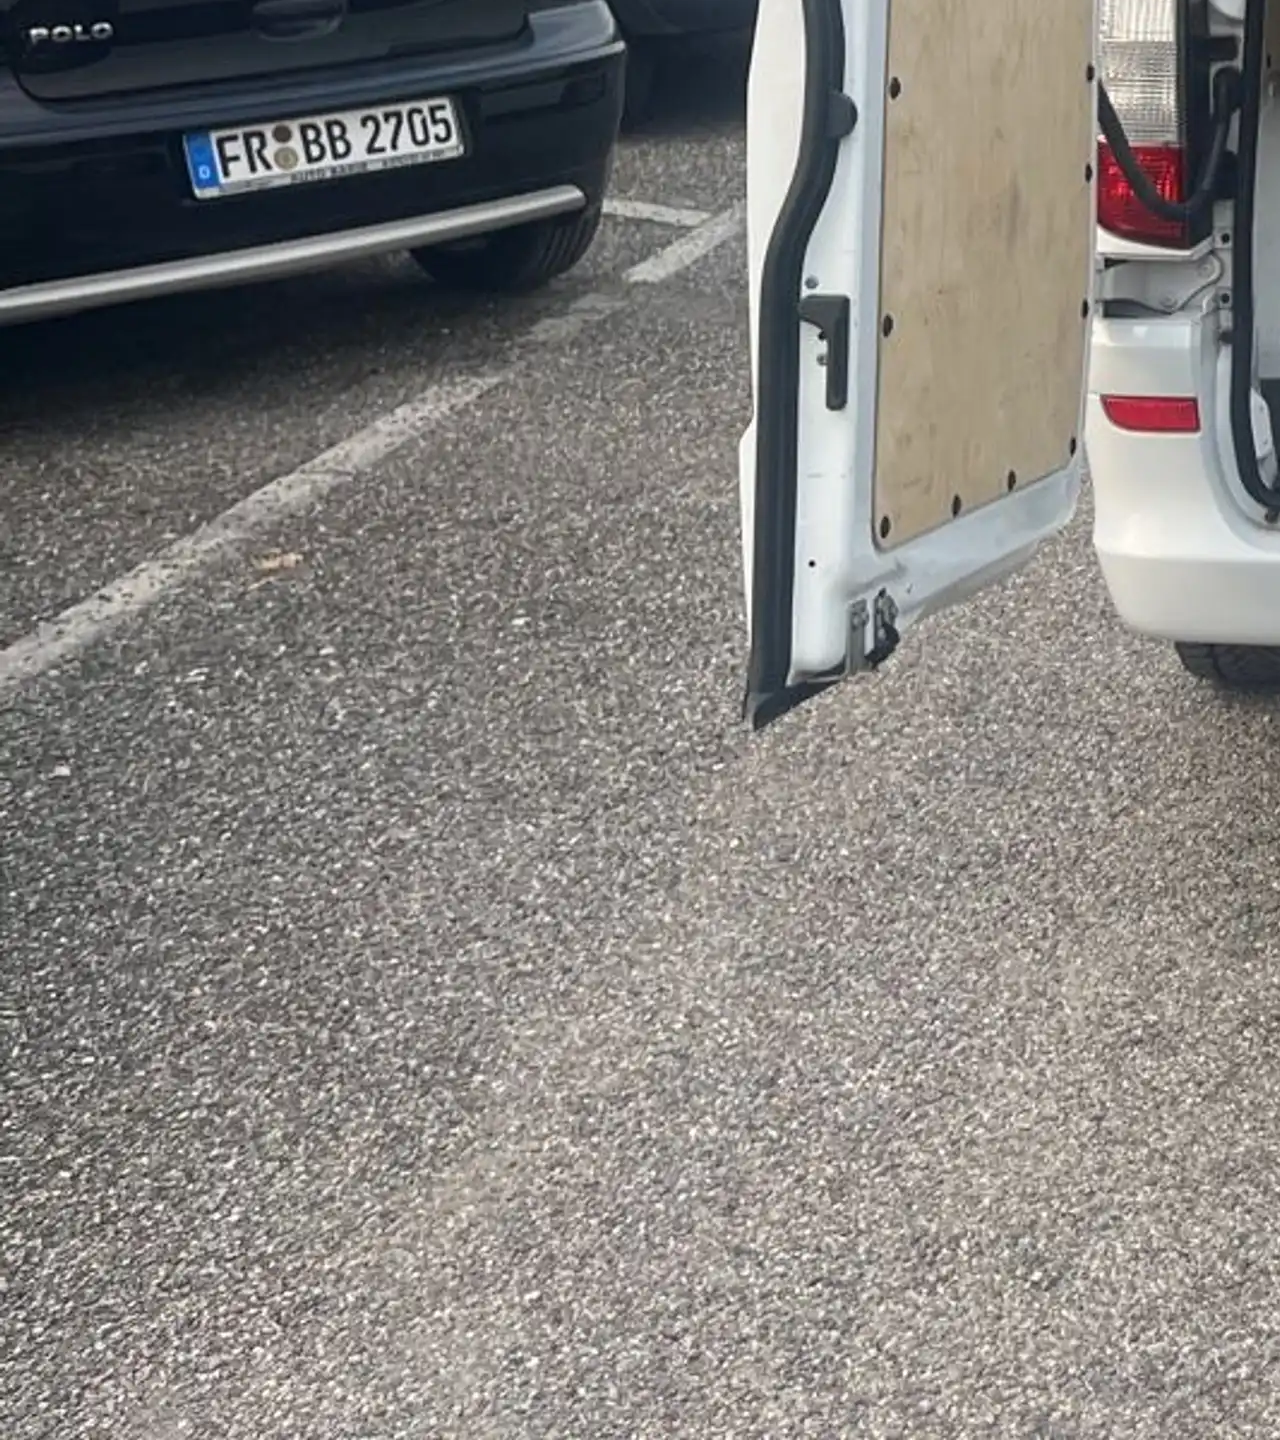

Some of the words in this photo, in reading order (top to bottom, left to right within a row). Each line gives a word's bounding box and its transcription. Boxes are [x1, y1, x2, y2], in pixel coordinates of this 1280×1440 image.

[29, 21, 114, 45] POLO
[215, 129, 274, 178] FR
[299, 119, 351, 164] BB
[360, 104, 452, 156] 2705
